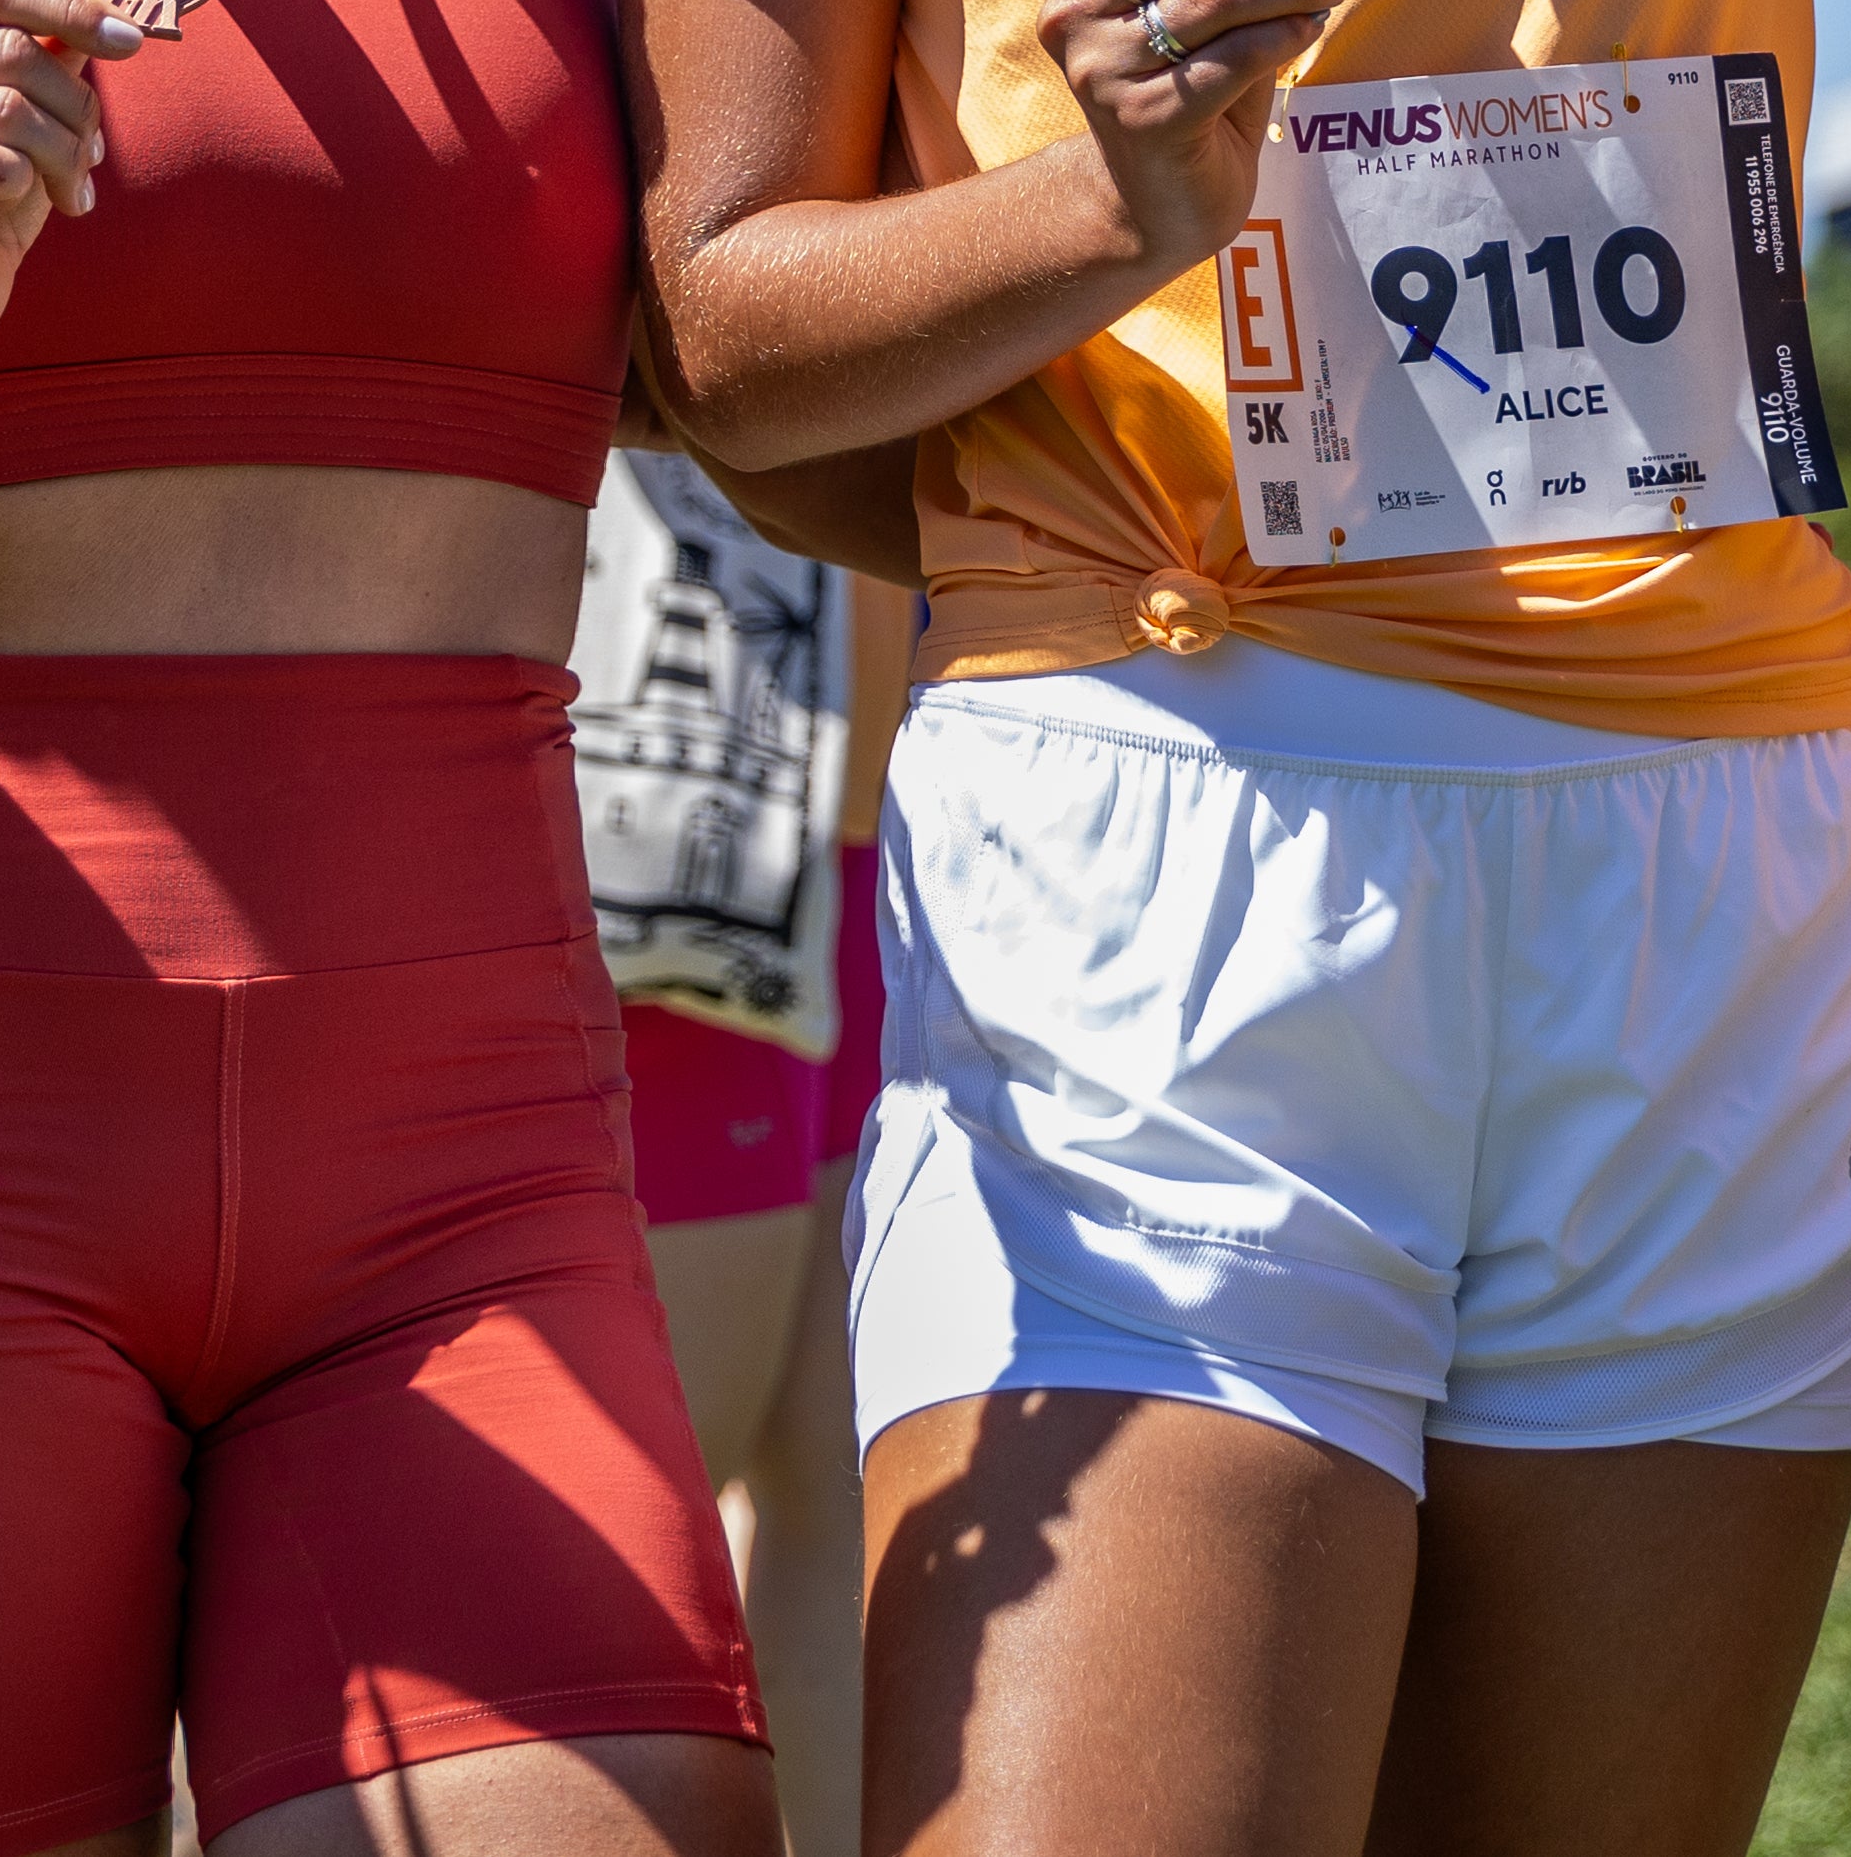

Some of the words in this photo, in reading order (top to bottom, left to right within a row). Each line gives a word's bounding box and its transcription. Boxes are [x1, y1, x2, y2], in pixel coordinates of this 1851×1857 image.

[1668, 72, 1699, 86] 9110
[1357, 153, 1418, 175] HALF
[1431, 142, 1562, 169] MARATHON
[1745, 156, 1759, 167] 11
[1761, 134, 1776, 187] TELEFONE
[1747, 170, 1762, 196] 955
[1767, 188, 1777, 203] DE
[1750, 198, 1765, 226] 006
[1753, 228, 1769, 254] 296
[1768, 205, 1785, 274] EMERGÊNCIA
[1231, 247, 1271, 367] E
[1371, 226, 1686, 364] 9110
[1495, 384, 1608, 423] ALICE
[1760, 392, 1790, 444] 9110
[1776, 344, 1817, 485] GUARDA-VOLUME
[1247, 402, 1289, 444] 5K
[1642, 454, 1675, 462] GOVERNO
[1542, 471, 1586, 497] rvb
[1627, 461, 1706, 488] BRASIL
